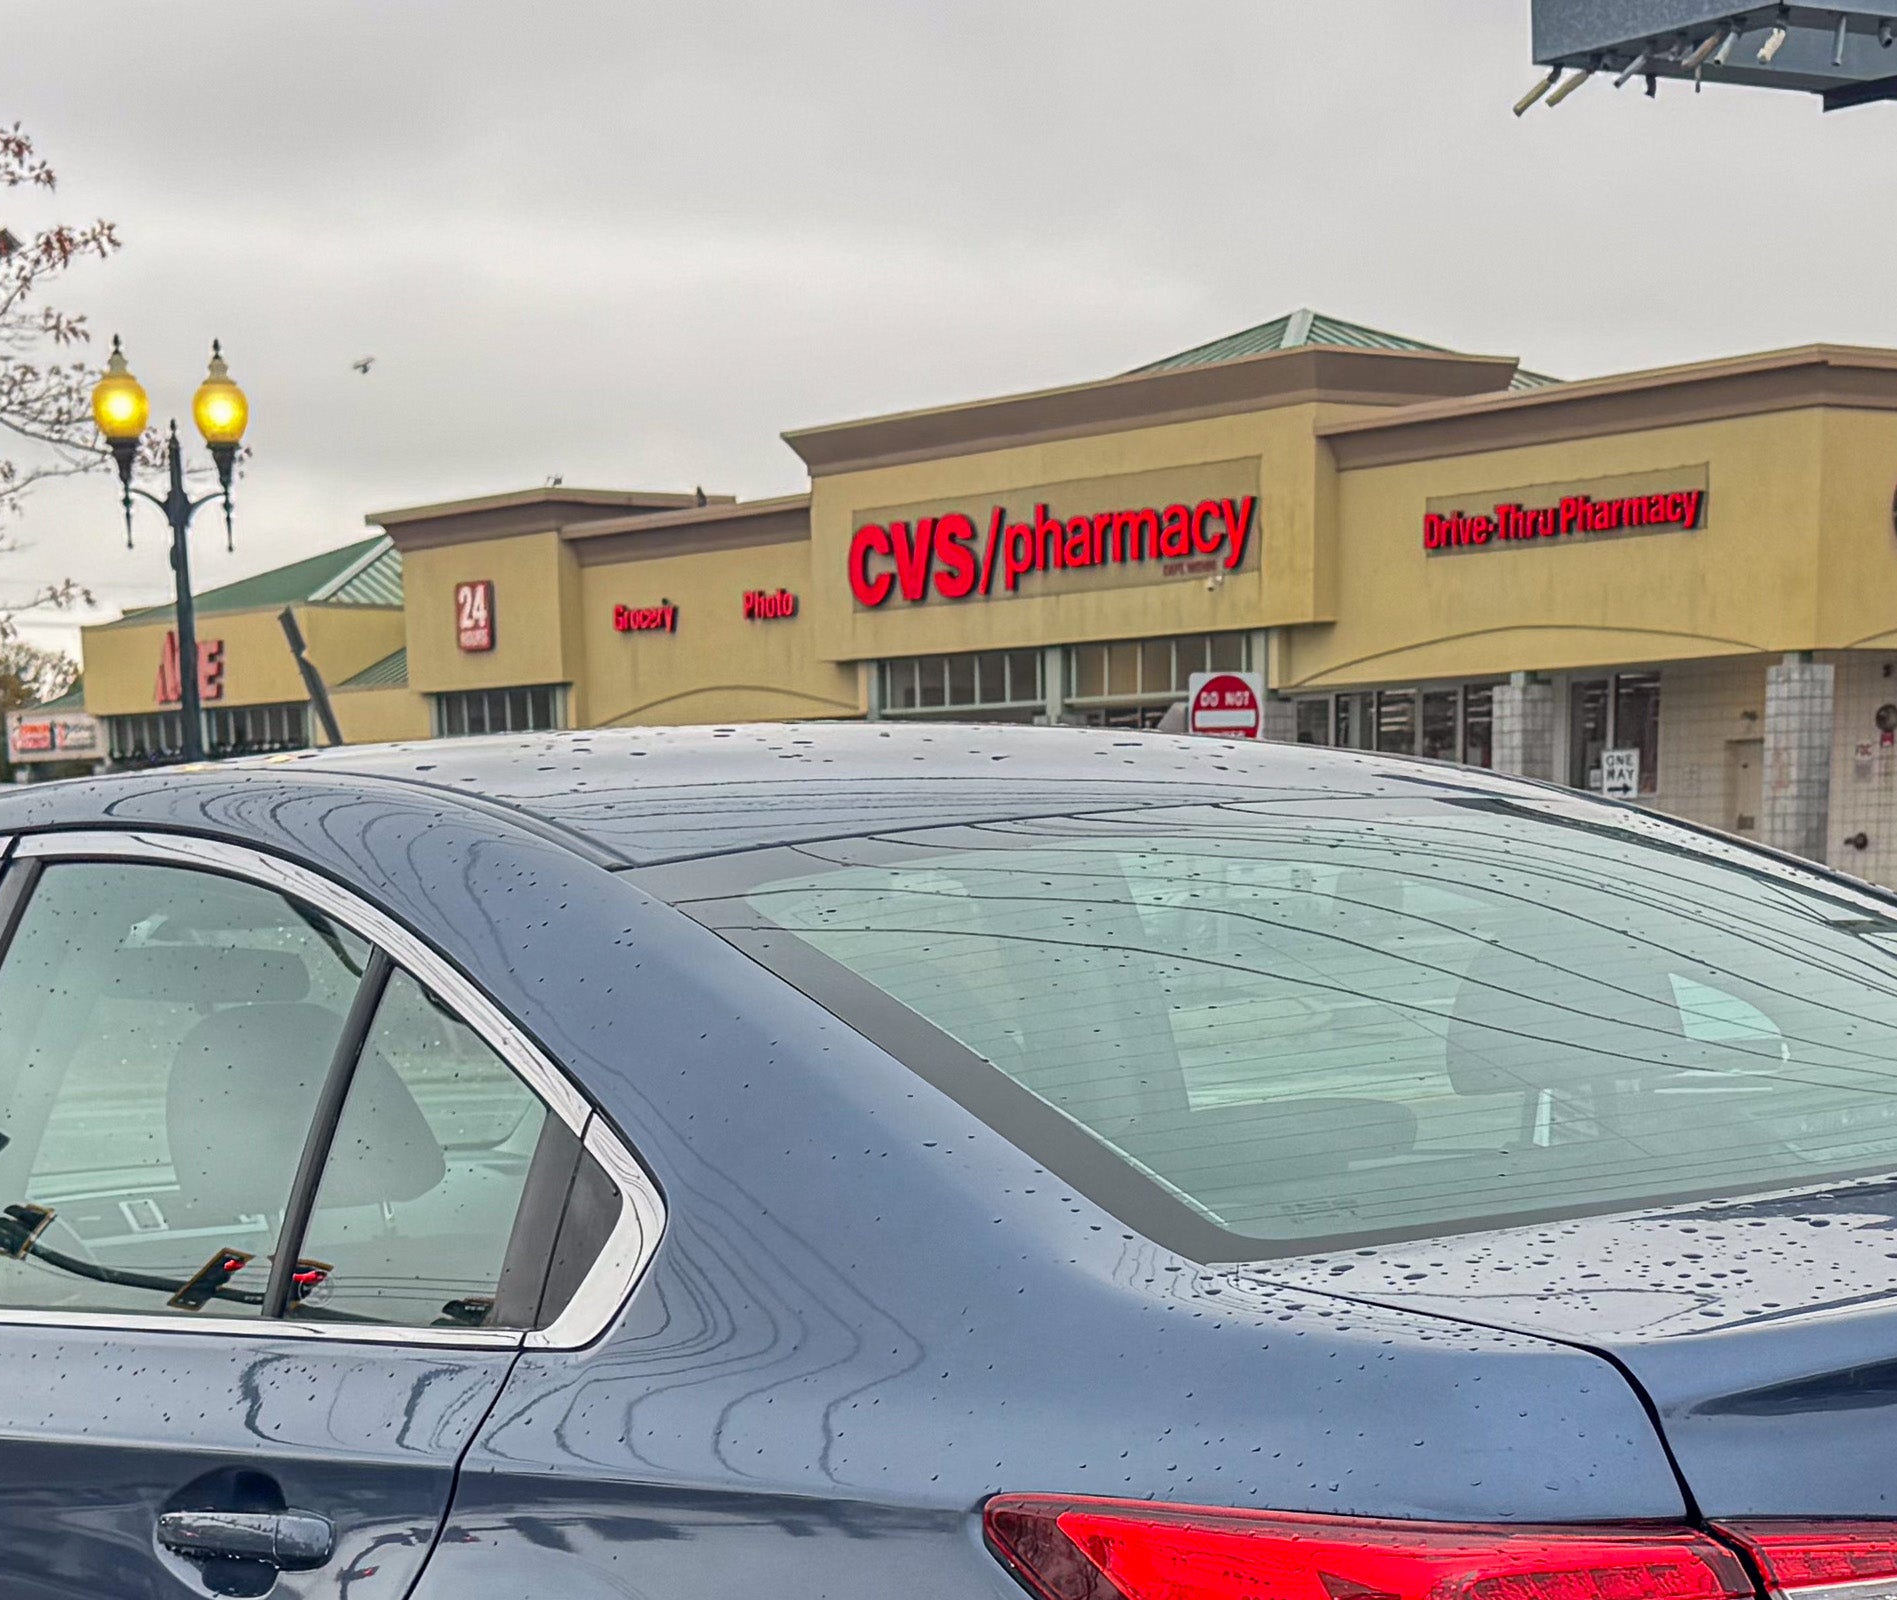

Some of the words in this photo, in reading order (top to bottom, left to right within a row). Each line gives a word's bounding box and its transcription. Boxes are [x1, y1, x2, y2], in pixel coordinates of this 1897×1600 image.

[1424, 502, 1557, 549] Drive-Thru
[1559, 489, 1702, 535] Pharmacy
[848, 495, 1255, 607] CVS/pharmacy
[458, 584, 488, 629] 24
[613, 603, 677, 634] Grocery
[742, 589, 796, 620] Photo
[155, 631, 224, 704] AE
[1200, 690, 1219, 707] DO
[1224, 690, 1250, 707] NOT
[1605, 753, 1634, 767] ONE
[1606, 768, 1635, 781] WAY
